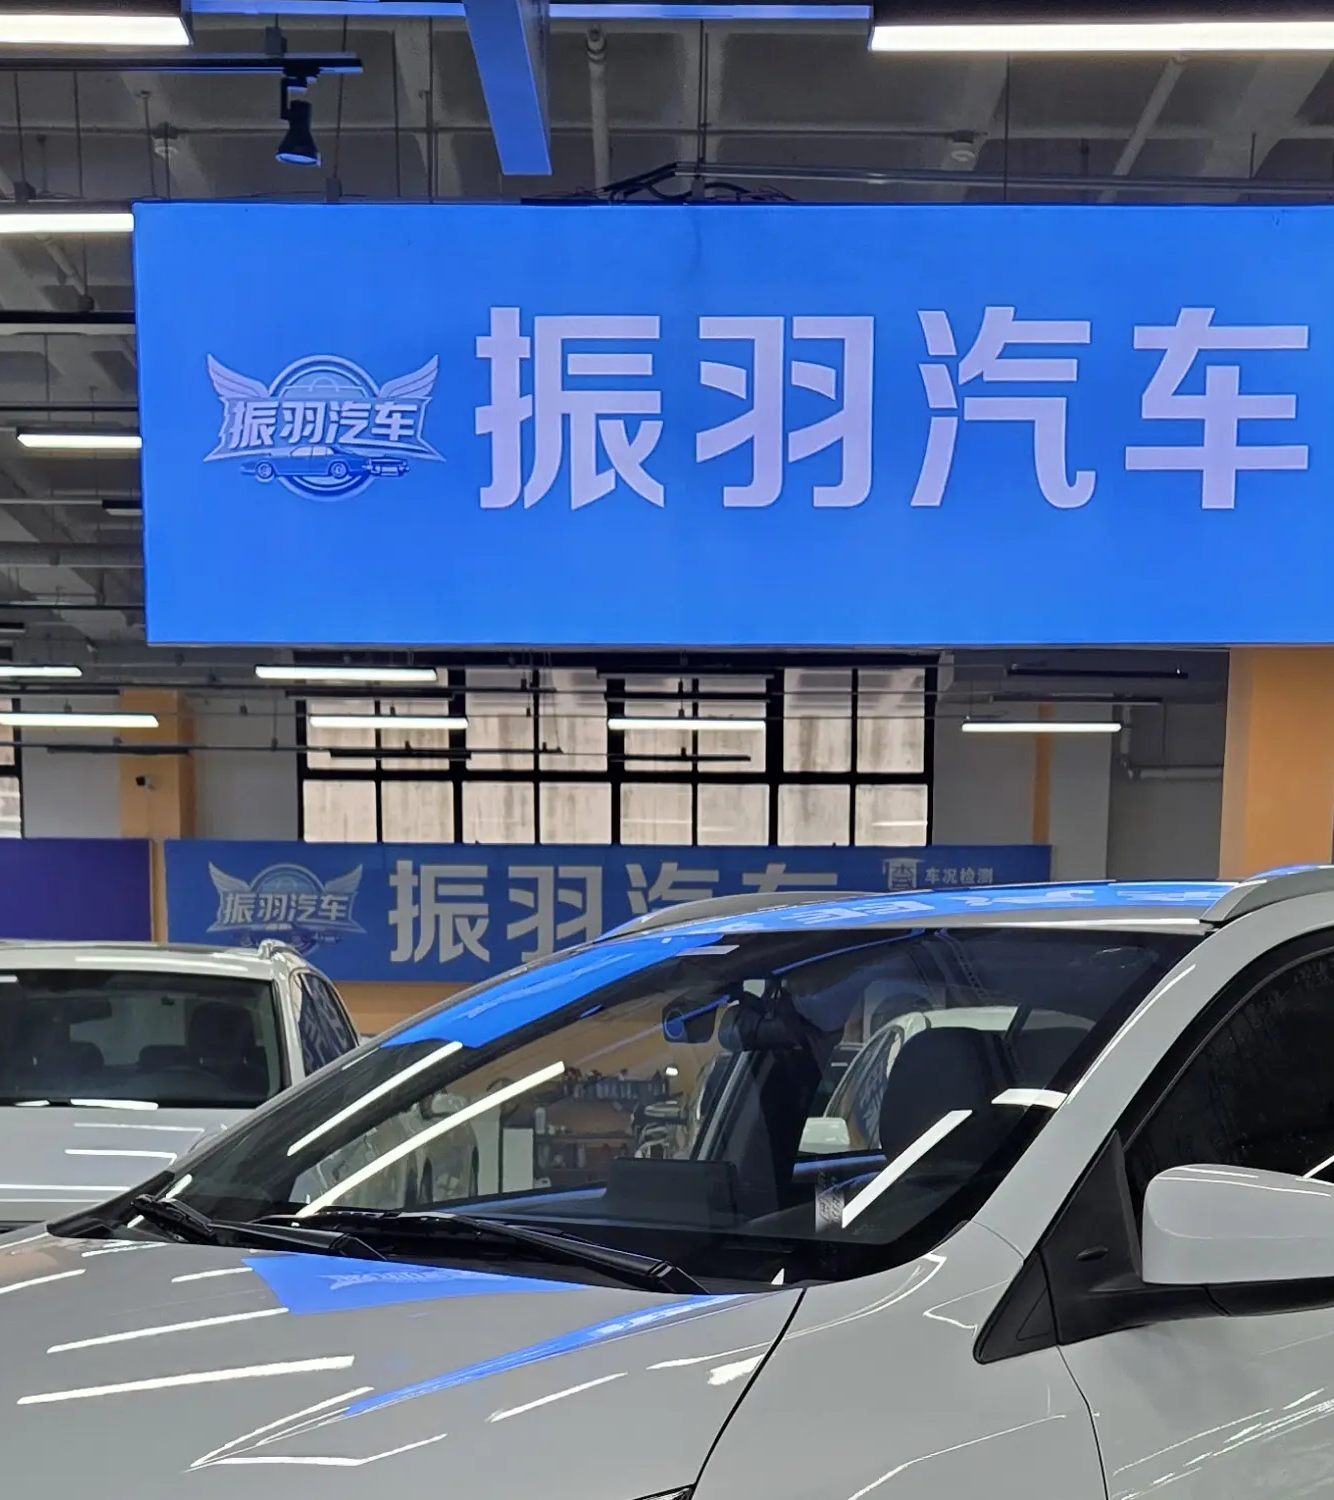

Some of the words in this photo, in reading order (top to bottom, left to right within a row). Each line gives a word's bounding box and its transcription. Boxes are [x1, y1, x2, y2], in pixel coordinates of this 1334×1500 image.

[229, 401, 418, 449] 振羽汽车
[475, 306, 1310, 511] 振羽汽车
[222, 892, 350, 924] 振羽汽车
